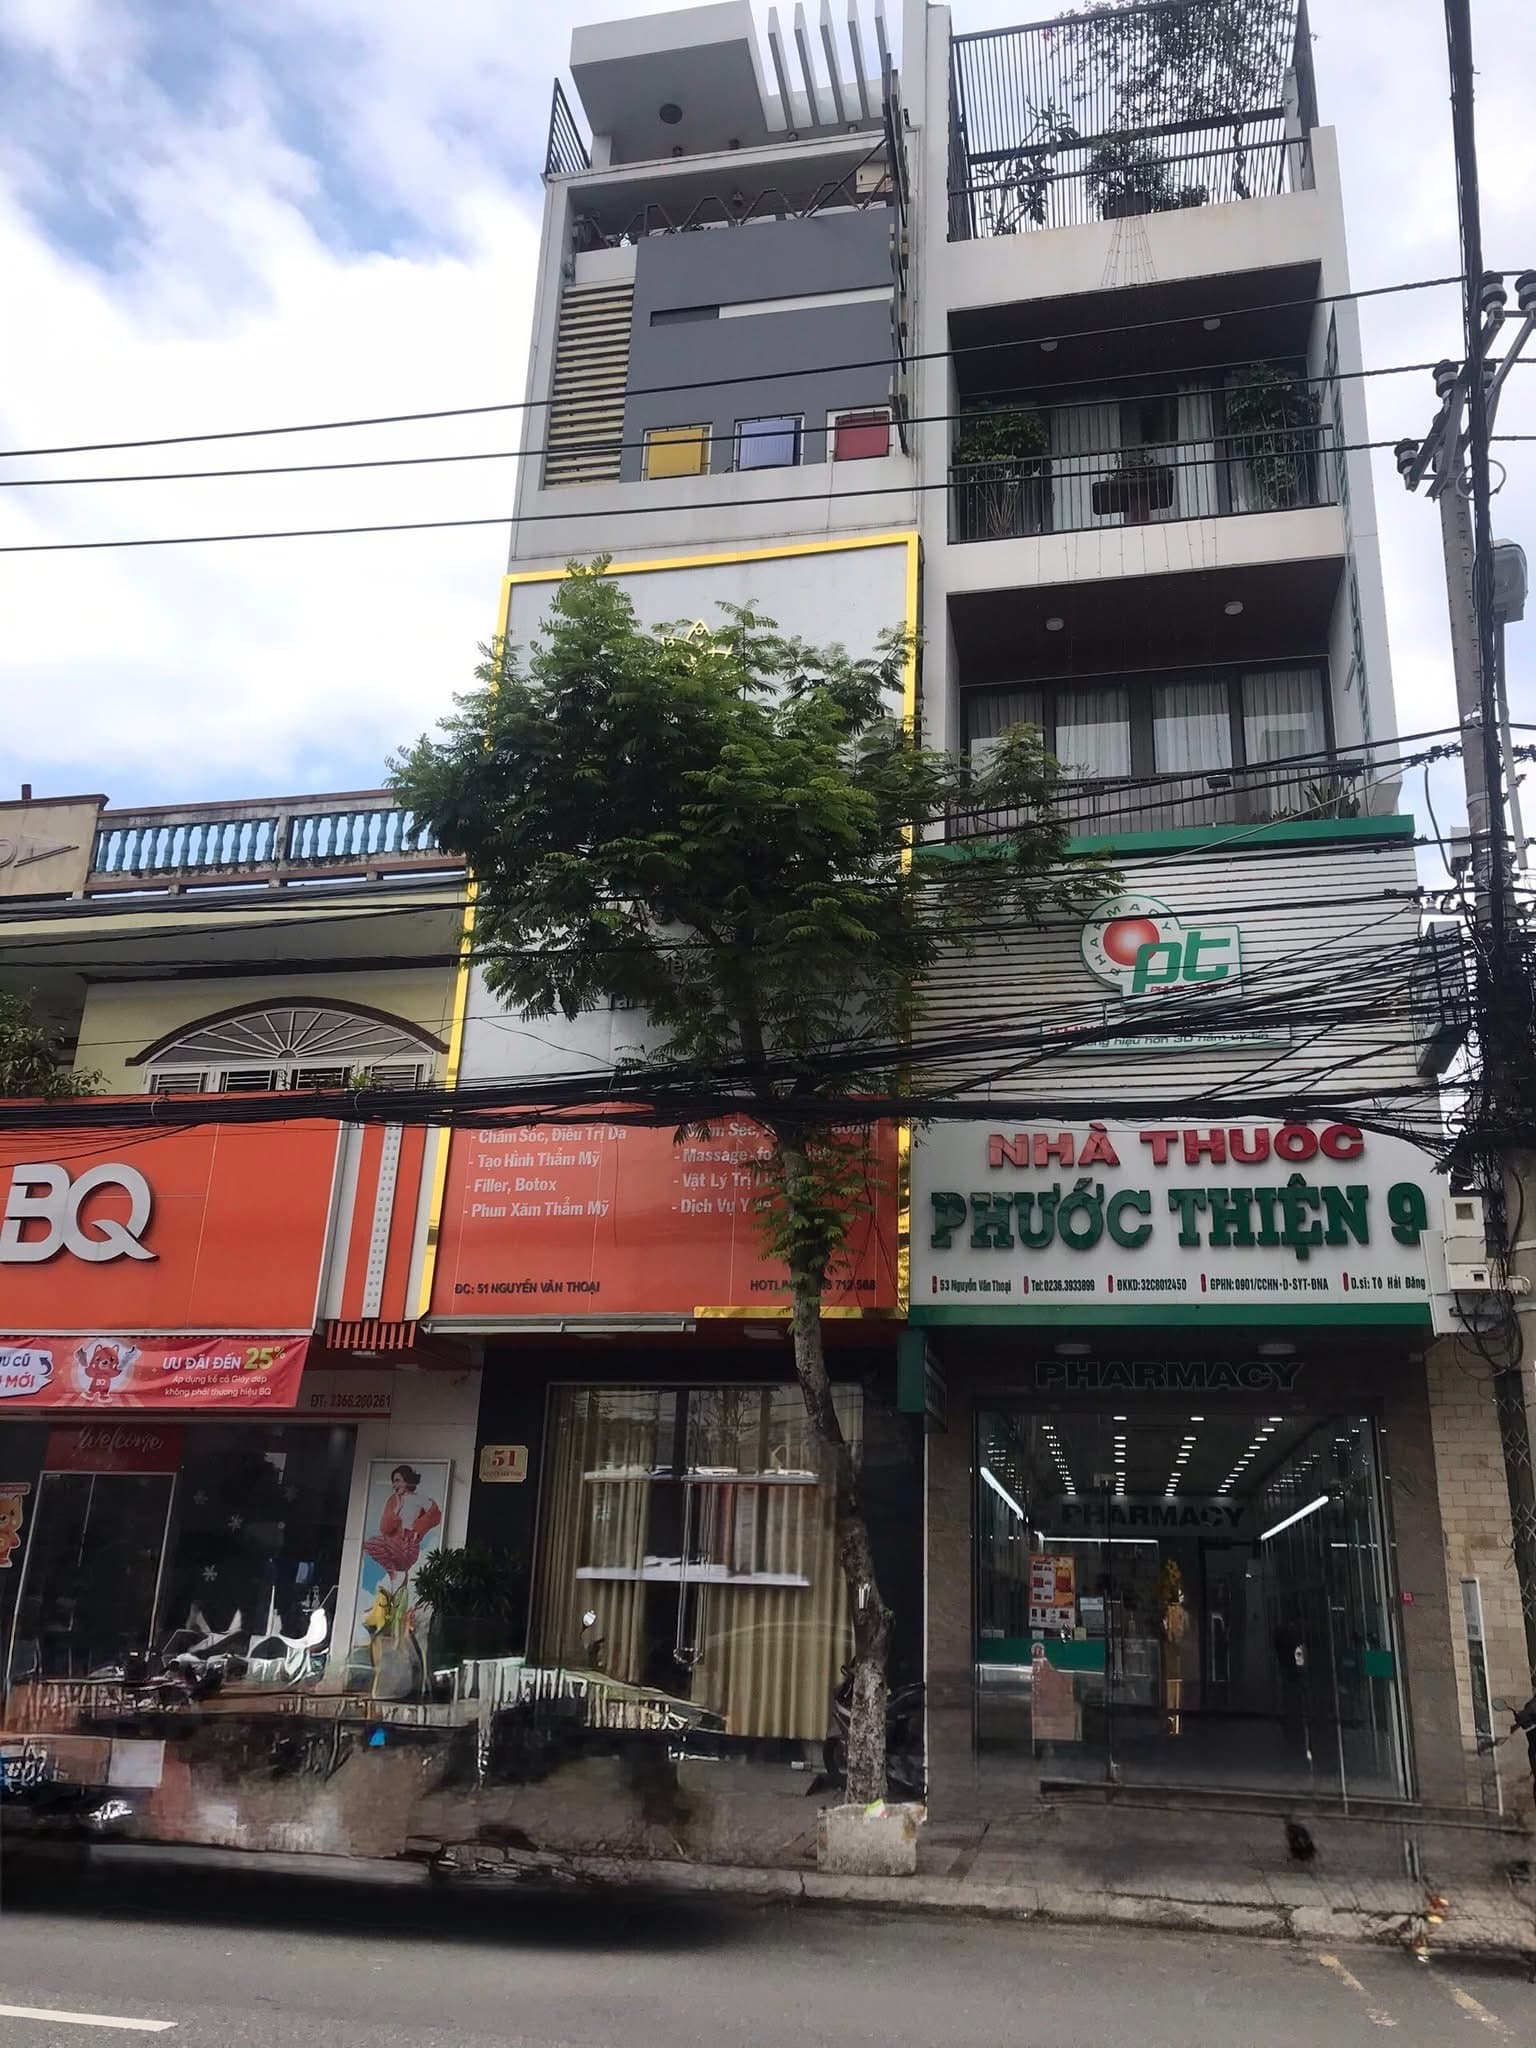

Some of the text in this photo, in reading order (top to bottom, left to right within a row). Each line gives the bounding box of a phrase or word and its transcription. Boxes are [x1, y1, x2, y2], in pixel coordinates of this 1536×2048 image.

[586, 1126, 605, 1144] Trị
[607, 1127, 627, 1140] Da
[988, 1119, 1365, 1168] NHÀ THUỐC
[478, 1147, 601, 1171] Tạo Hình Thẩm Mỹ
[682, 1148, 747, 1165] Massage
[473, 1178, 557, 1195] Filler, Botox
[682, 1173, 706, 1192] Vật
[710, 1172, 728, 1190] Lý
[732, 1172, 751, 1190] Trị
[0, 1162, 159, 1263] BQ
[471, 1196, 609, 1218] Phun Xăm Thẩm Mỹ
[680, 1199, 713, 1217] Dịch
[717, 1199, 736, 1217] Vụ
[740, 1199, 749, 1213] Y
[930, 1173, 1429, 1262] PHƯỚC THIỆN 9
[454, 1283, 475, 1295] ĐC:
[477, 1282, 489, 1294] 51
[540, 1279, 563, 1293] VĂN
[566, 1280, 601, 1295] THOẠI
[939, 1279, 950, 1292] 53
[13, 1353, 31, 1367] CŨ
[162, 1346, 286, 1370] ƯU ĐÃI ĐẾN 25%
[5, 1372, 35, 1389] MỚI
[1034, 1361, 1305, 1391] PHARMACY
[258, 1386, 272, 1396] BQ
[491, 1449, 516, 1467] 51
[1062, 1503, 1246, 1530] PHARMACY
